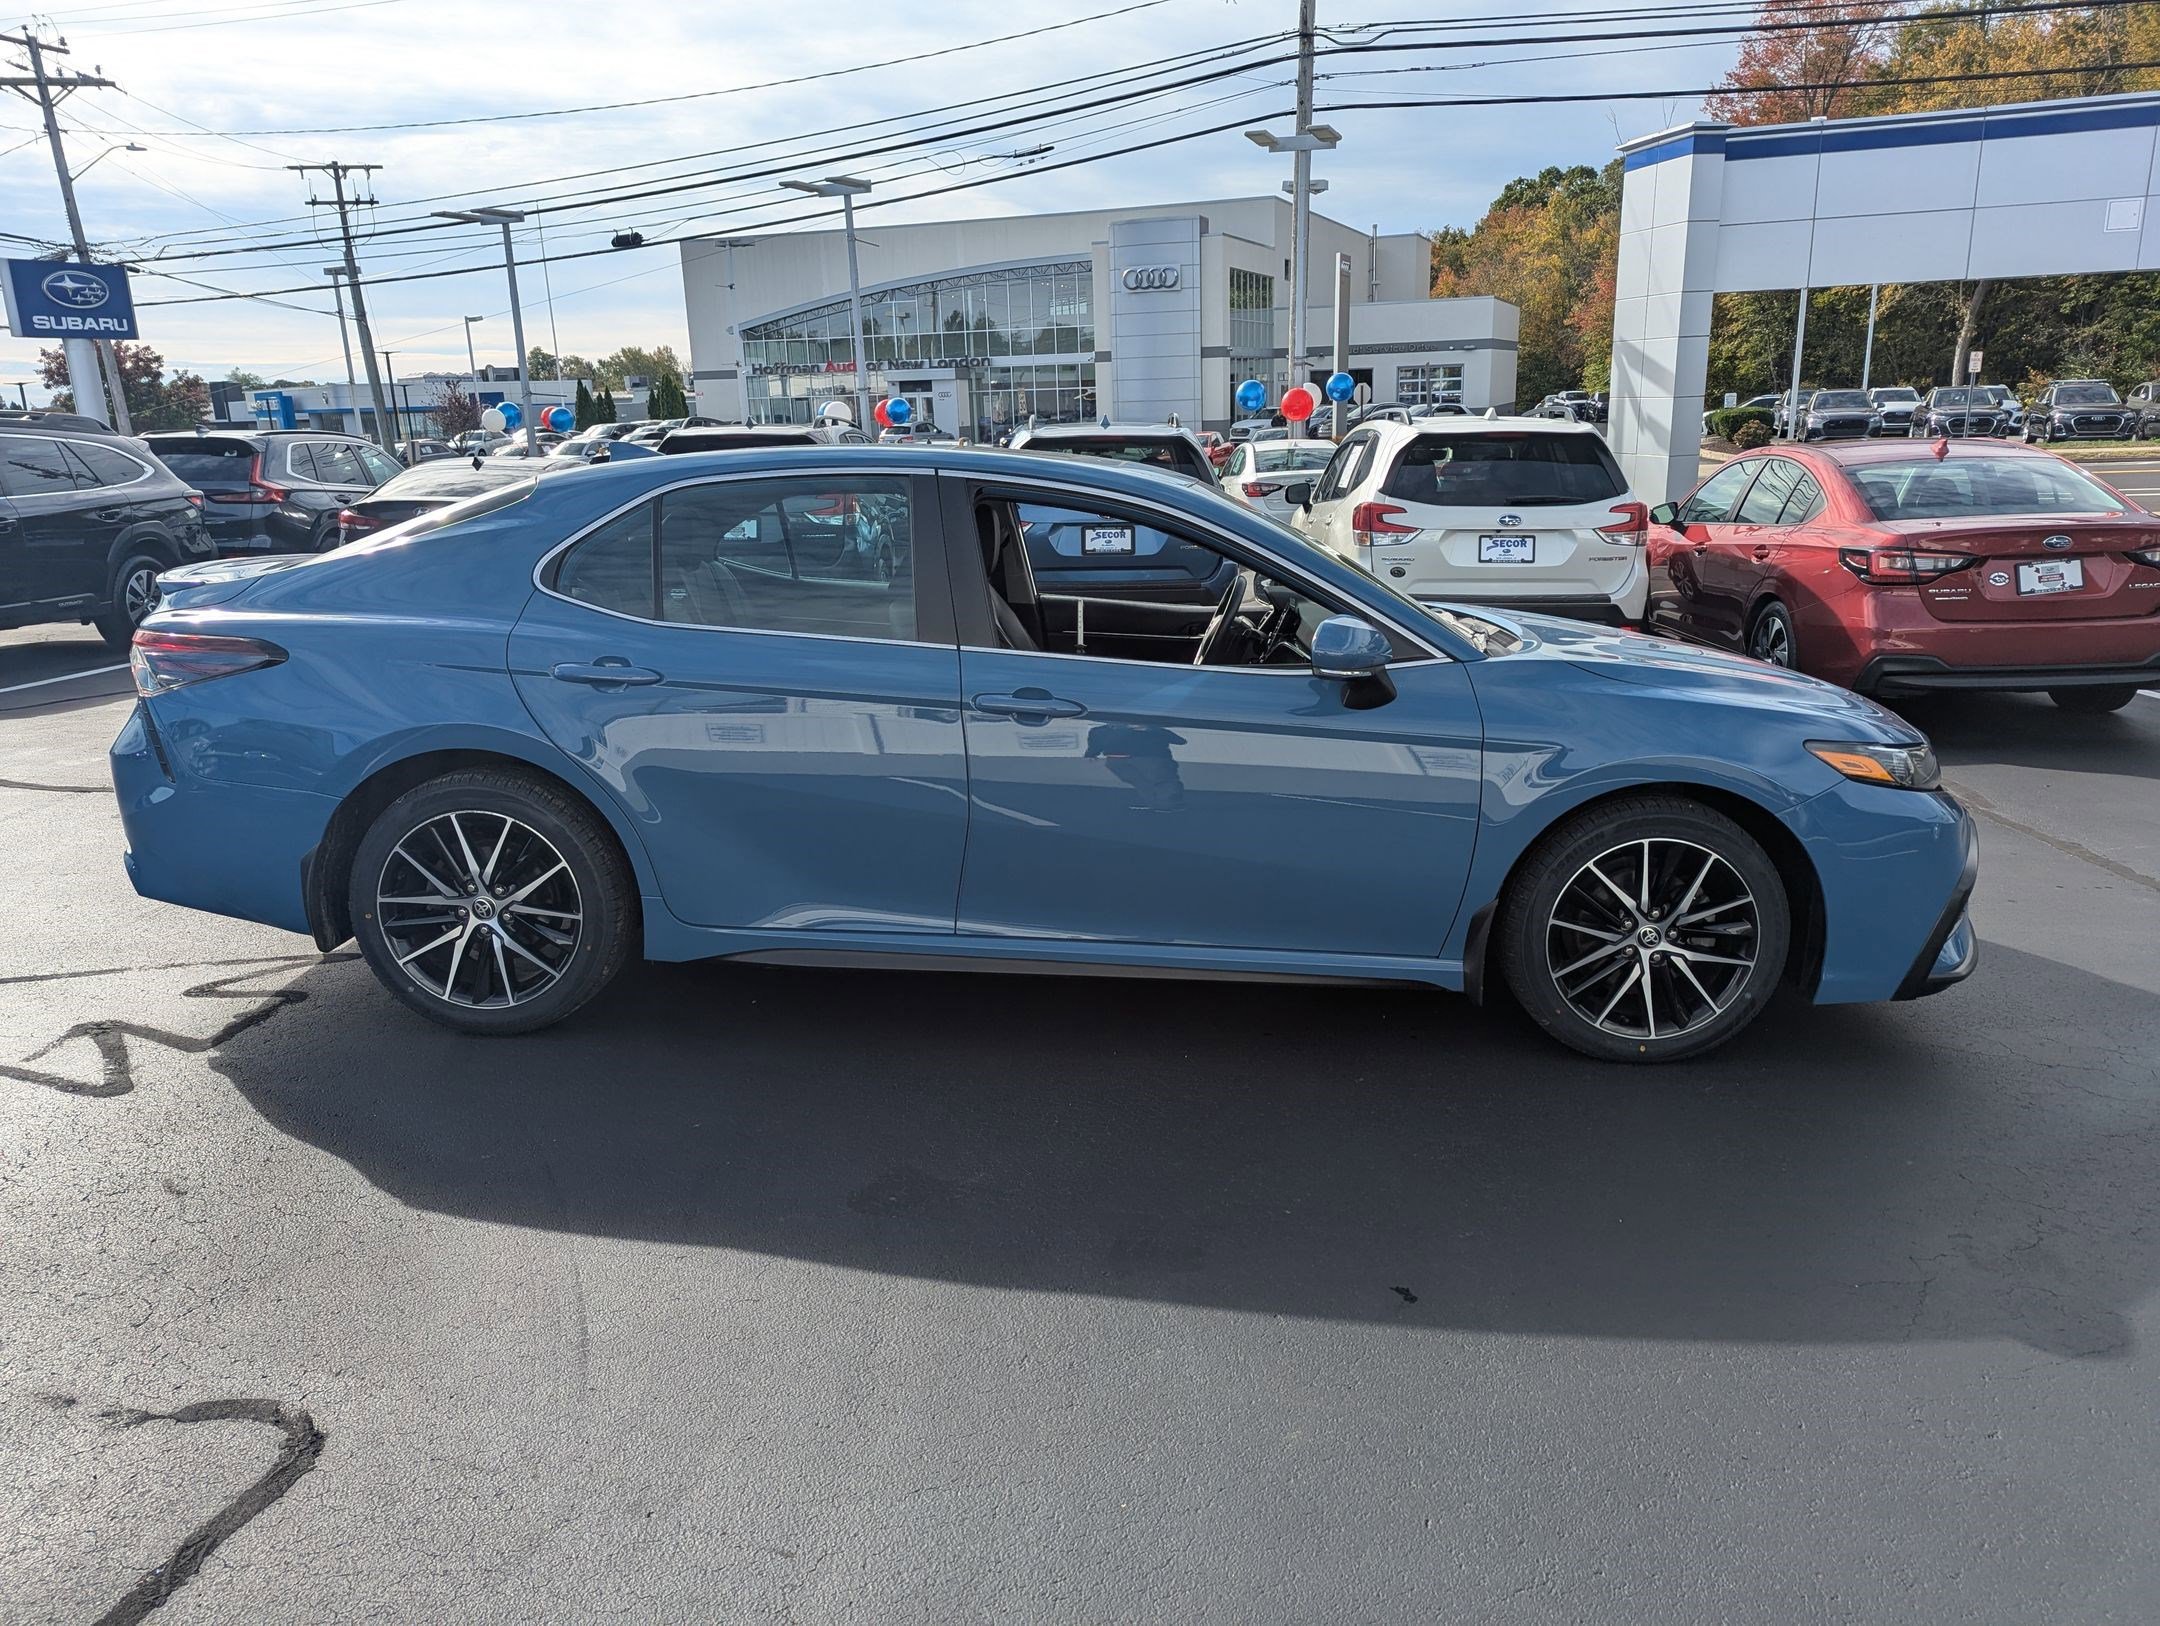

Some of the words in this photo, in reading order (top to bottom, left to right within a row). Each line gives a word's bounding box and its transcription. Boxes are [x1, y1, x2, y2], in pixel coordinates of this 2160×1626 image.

[32, 315, 129, 331] SUBARU
[1366, 344, 1405, 353] Service
[1408, 342, 1438, 352] Drive
[751, 362, 820, 375] Hoffman
[824, 360, 857, 373] Aud
[865, 359, 884, 371] of
[887, 358, 924, 370] New
[928, 356, 991, 369] London
[1091, 531, 1126, 542] SECOR
[1486, 540, 1528, 552] SECOR
